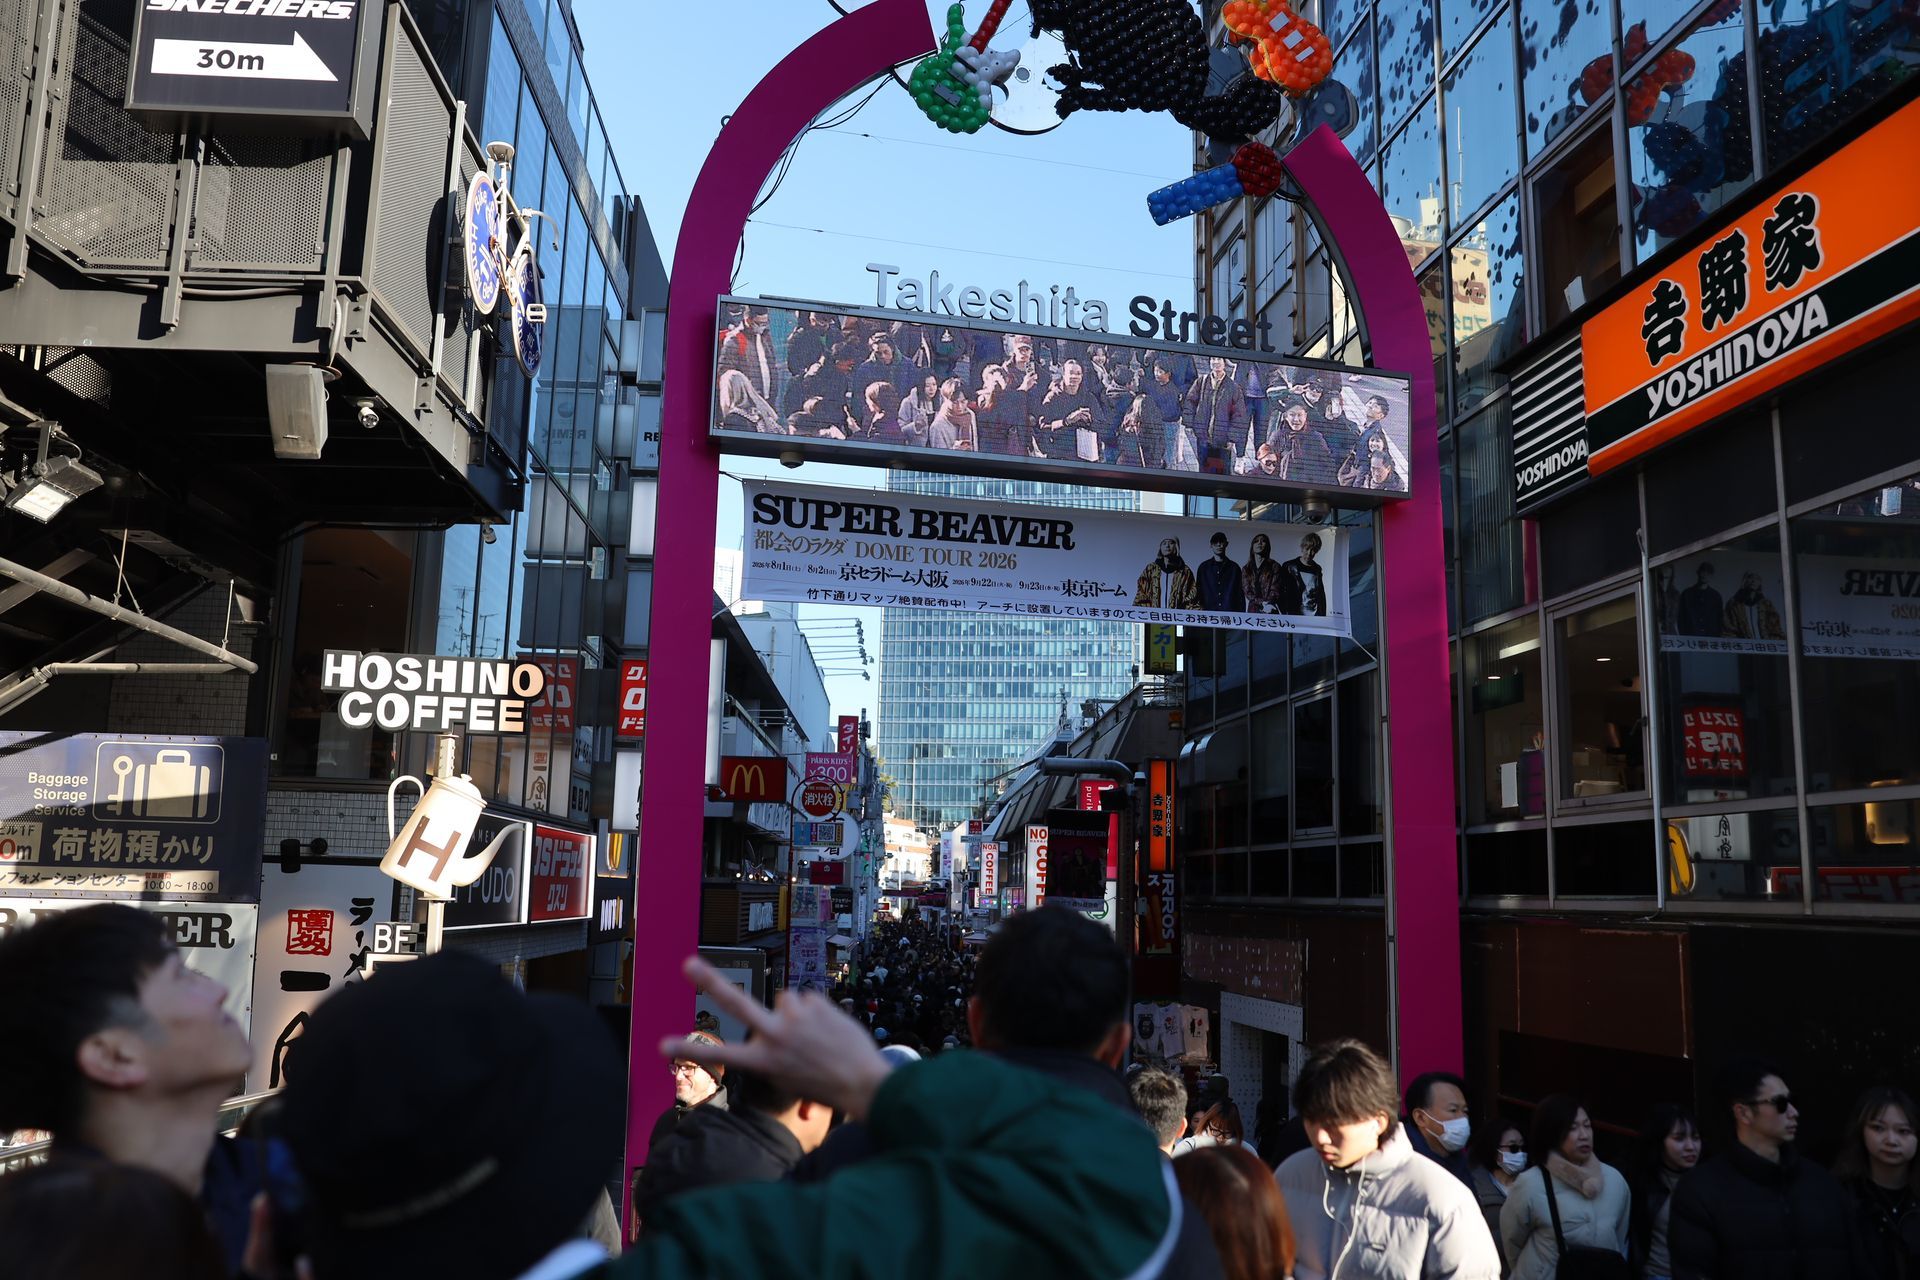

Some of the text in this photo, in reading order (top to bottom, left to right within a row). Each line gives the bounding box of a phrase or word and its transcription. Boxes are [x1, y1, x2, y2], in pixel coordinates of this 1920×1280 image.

[146, 0, 355, 20] SKECHERS
[196, 48, 265, 71] 30m
[1641, 193, 1822, 367] 吉野家
[865, 262, 1276, 351] Takeshita Street
[1646, 293, 1829, 420] YOSHINOYA
[1516, 438, 1588, 492] YOSHINOYA
[752, 493, 1076, 551] SUPER BEAVER
[754, 529, 1018, 571] 都会のラクダ DOME TOUR 2026
[838, 562, 949, 589] 京セラドーム大阪
[1060, 578, 1128, 598] 東京ドーム
[324, 653, 544, 698] HOSHINO
[341, 691, 525, 733] COFFEE
[28, 772, 89, 787] Baggage
[33, 788, 88, 803] Storage
[804, 792, 834, 807] 消火栓
[35, 803, 86, 817] Service
[52, 826, 214, 864] 荷物預かり
[397, 815, 461, 882] H
[145, 879, 172, 890] 10:00
[187, 881, 214, 891] 18:00
[985, 852, 994, 895] COFFEE
[374, 924, 413, 954] BF
